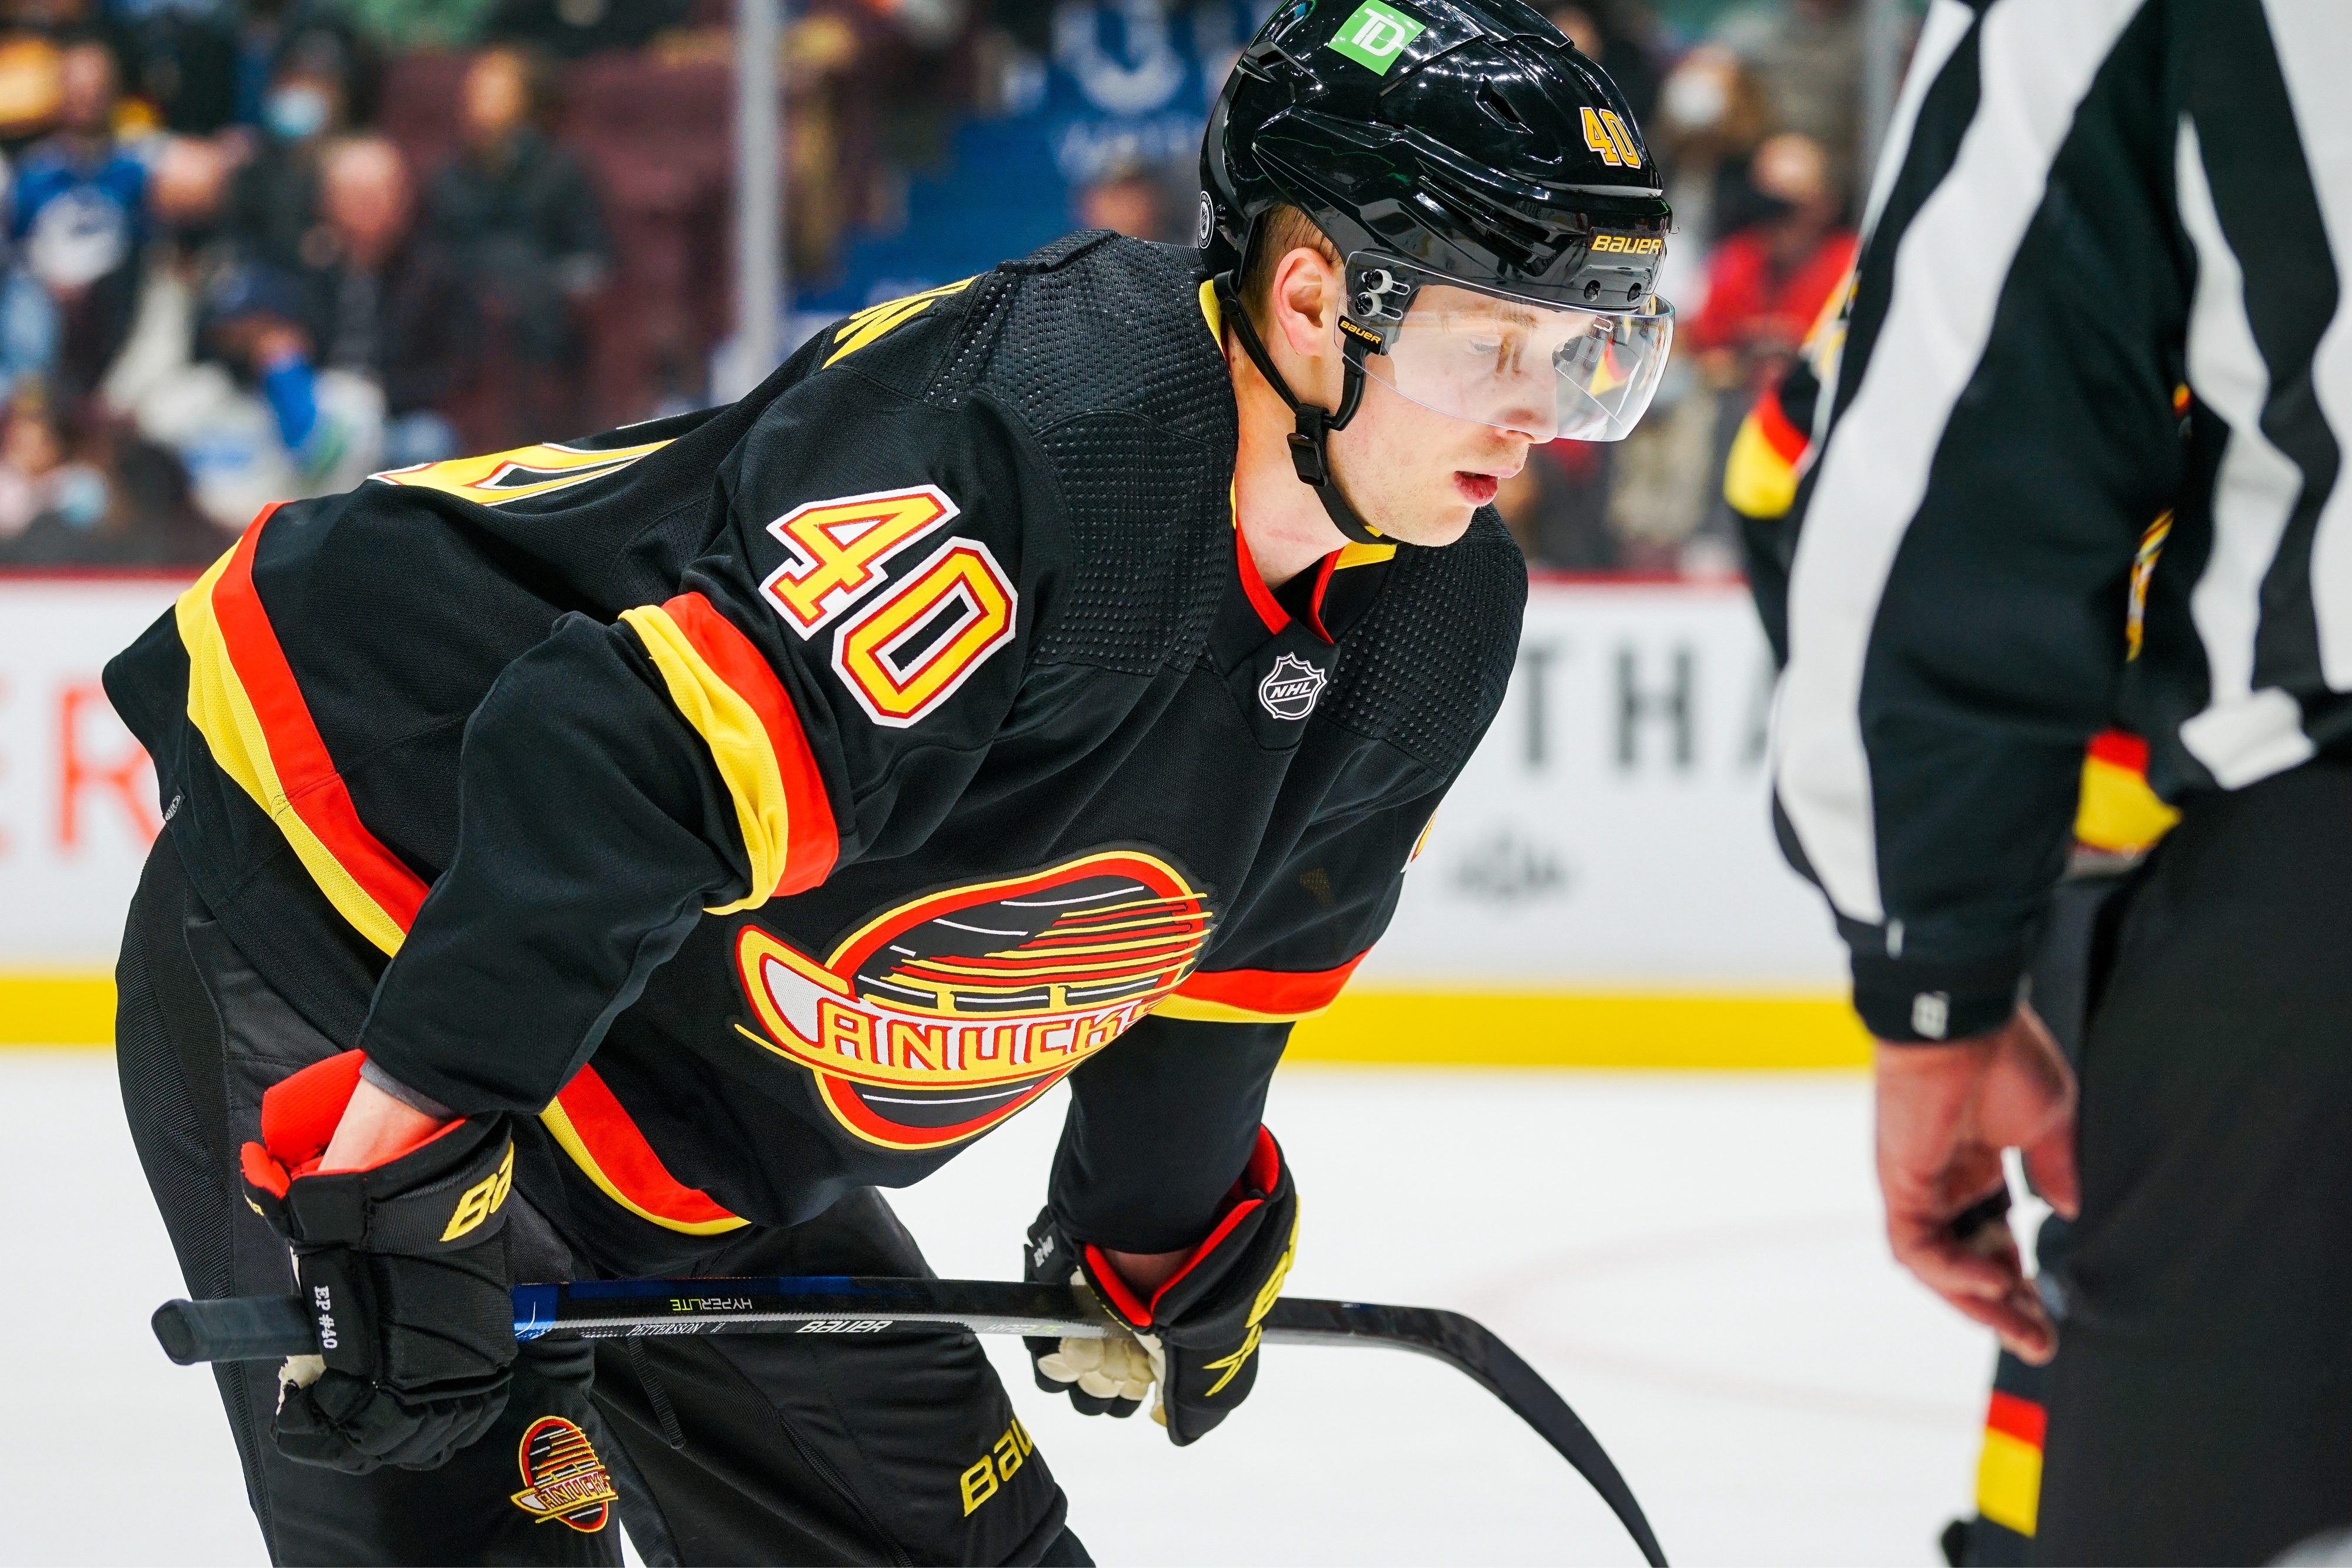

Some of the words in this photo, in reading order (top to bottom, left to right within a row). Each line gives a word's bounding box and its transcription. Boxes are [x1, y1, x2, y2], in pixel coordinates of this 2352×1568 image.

[1351, 8, 1406, 56] TD
[1579, 106, 1641, 169] 40
[1591, 235, 1662, 255] BAUER
[1339, 320, 1381, 345] BAUER
[759, 484, 1018, 728] 40
[1269, 681, 1311, 698] NHL
[315, 1285, 330, 1310] EP
[670, 1298, 753, 1311] HYPERLITE
[318, 1314, 338, 1349] #40
[626, 1322, 706, 1337] PETTERSSON
[795, 1320, 893, 1333] BAUER
